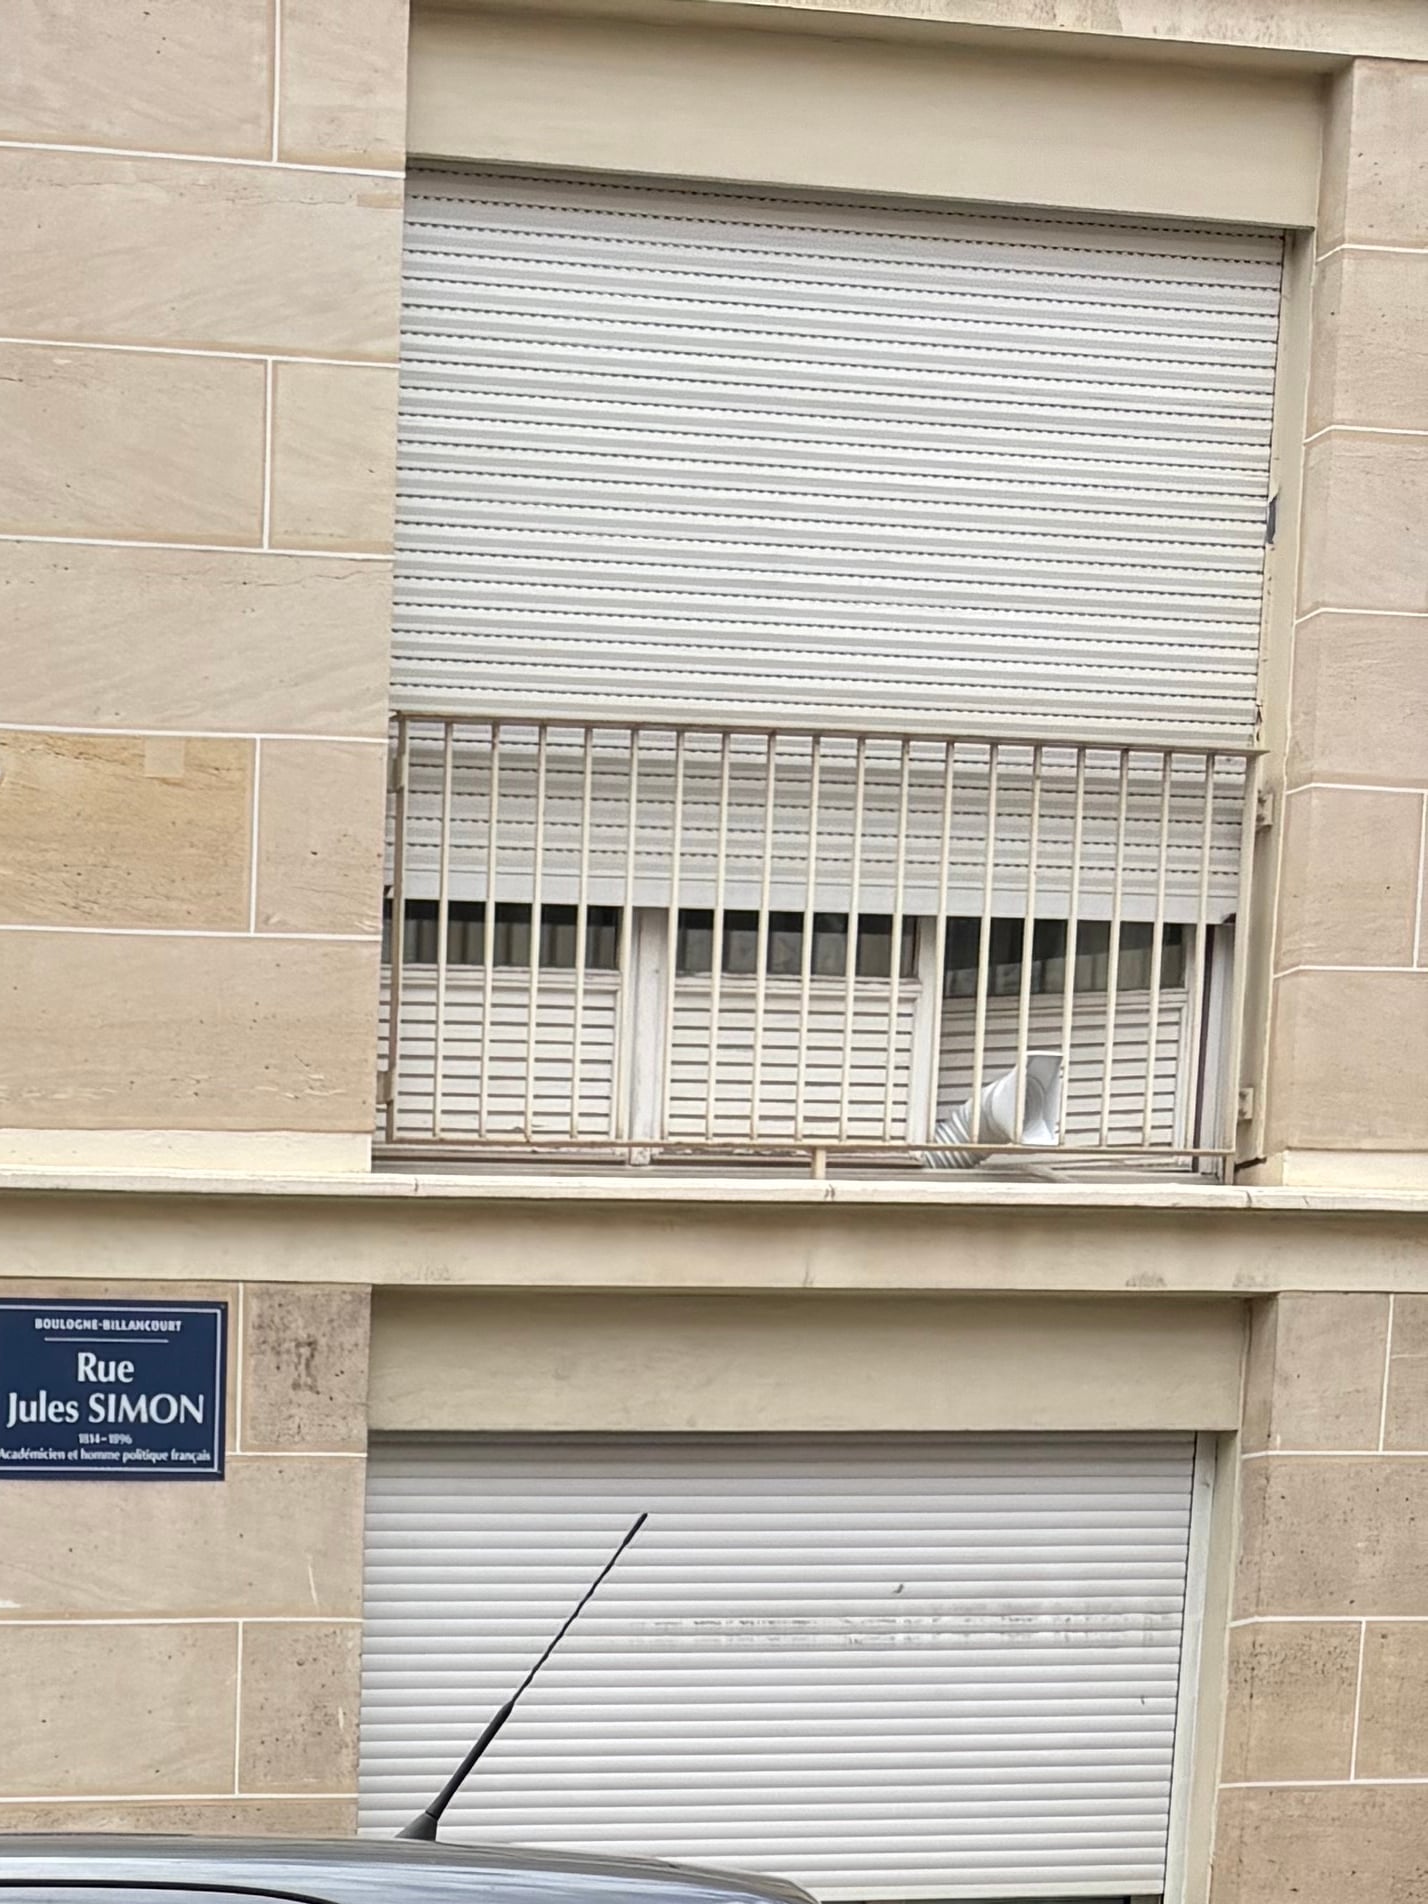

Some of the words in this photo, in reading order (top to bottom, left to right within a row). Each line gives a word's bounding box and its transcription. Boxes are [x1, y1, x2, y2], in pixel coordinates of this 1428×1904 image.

[34, 1318, 182, 1332] BOULOGNE-BILLANCOURT
[76, 1352, 135, 1383] Rue
[6, 1390, 79, 1428] Jules
[88, 1392, 205, 1425] SIMON
[67, 1449, 78, 1460] et
[80, 1449, 121, 1461] homme
[122, 1449, 169, 1463] politique
[171, 1449, 211, 1463] français
